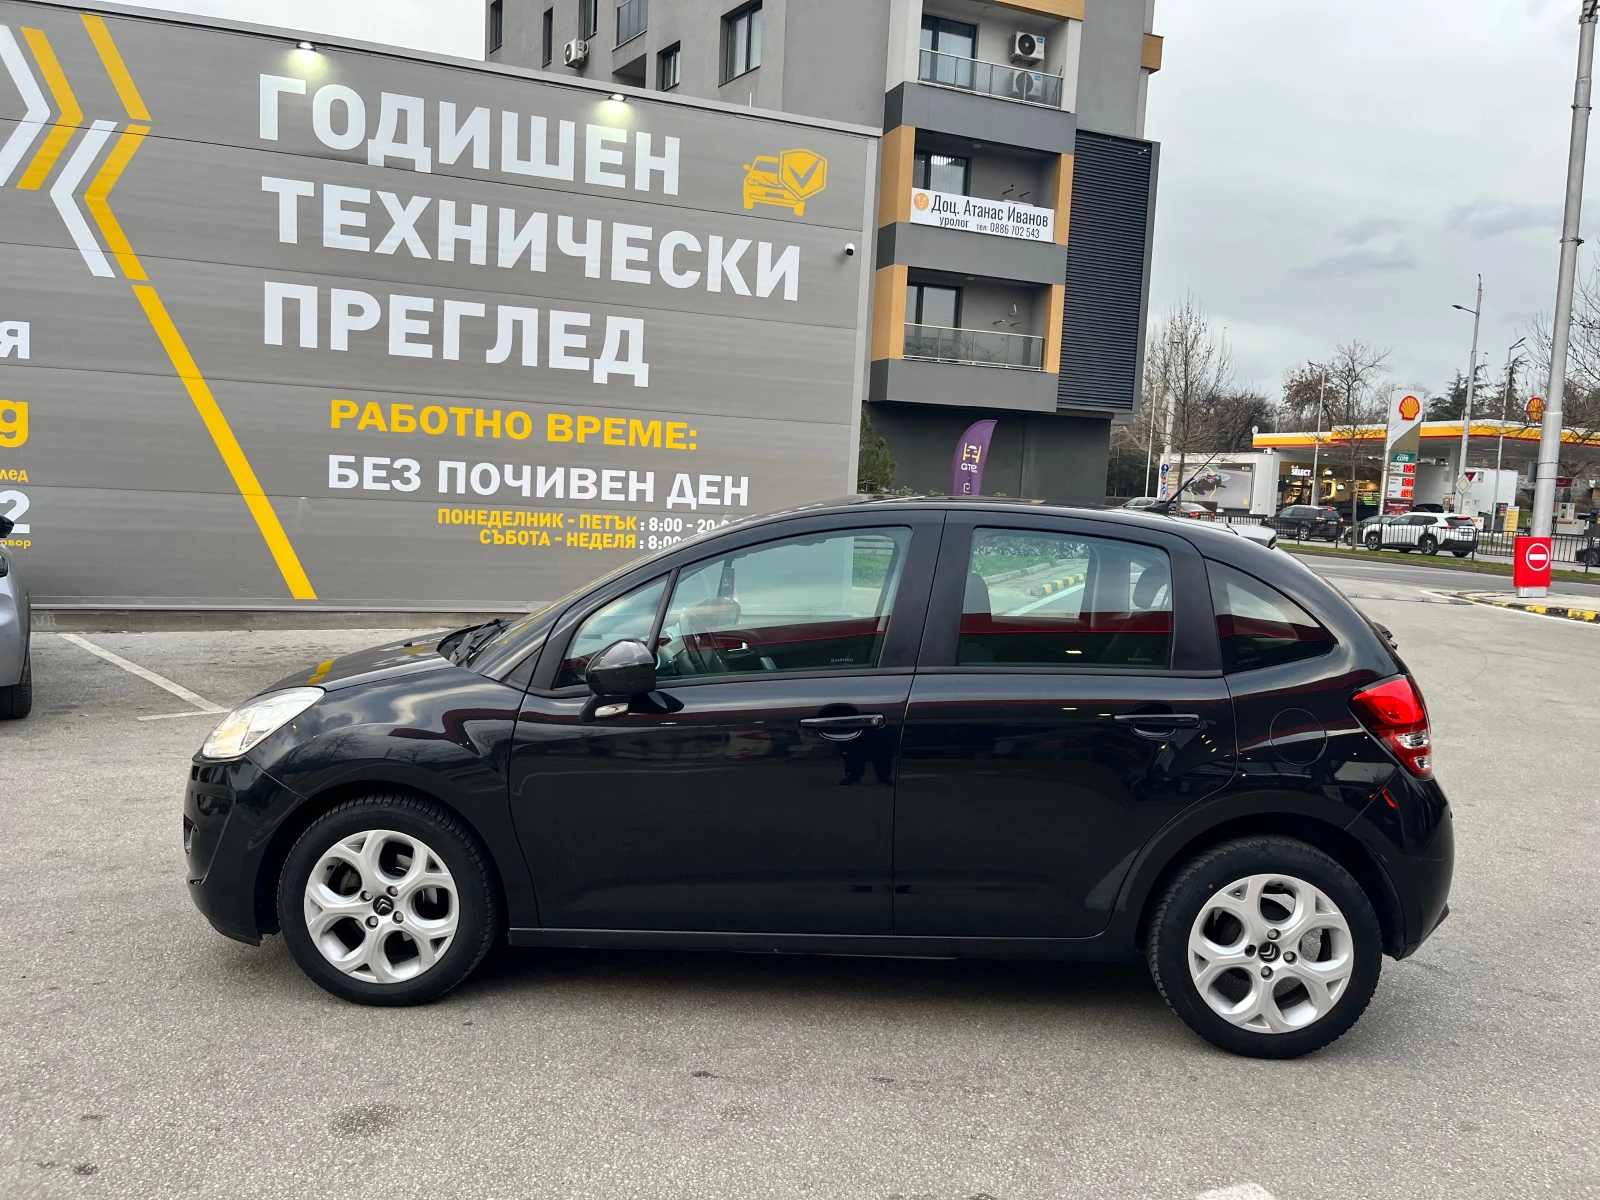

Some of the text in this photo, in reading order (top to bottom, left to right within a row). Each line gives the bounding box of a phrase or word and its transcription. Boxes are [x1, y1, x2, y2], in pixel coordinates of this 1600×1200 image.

[259, 74, 680, 195] ГОДИШЕН
[931, 195, 1049, 228] Доц. Атанас Иванов
[939, 216, 970, 229] уролог
[990, 223, 1009, 234] 0886
[1011, 225, 1024, 237] 702
[1026, 228, 1040, 239] 543
[261, 176, 800, 301] ТЕХНИЧЕСКИ
[263, 281, 650, 387] ПРЕГЛЕД
[330, 399, 698, 450] РАБОТНО ВРЕМЕ:
[328, 454, 748, 510] БЕЗ ПОЧИВЕН ДЕН
[1291, 468, 1311, 477] SELECT
[437, 508, 564, 529] ПОНЕДЕЛНИК
[648, 516, 683, 533] 8:00
[479, 529, 551, 546] СЪБОТА
